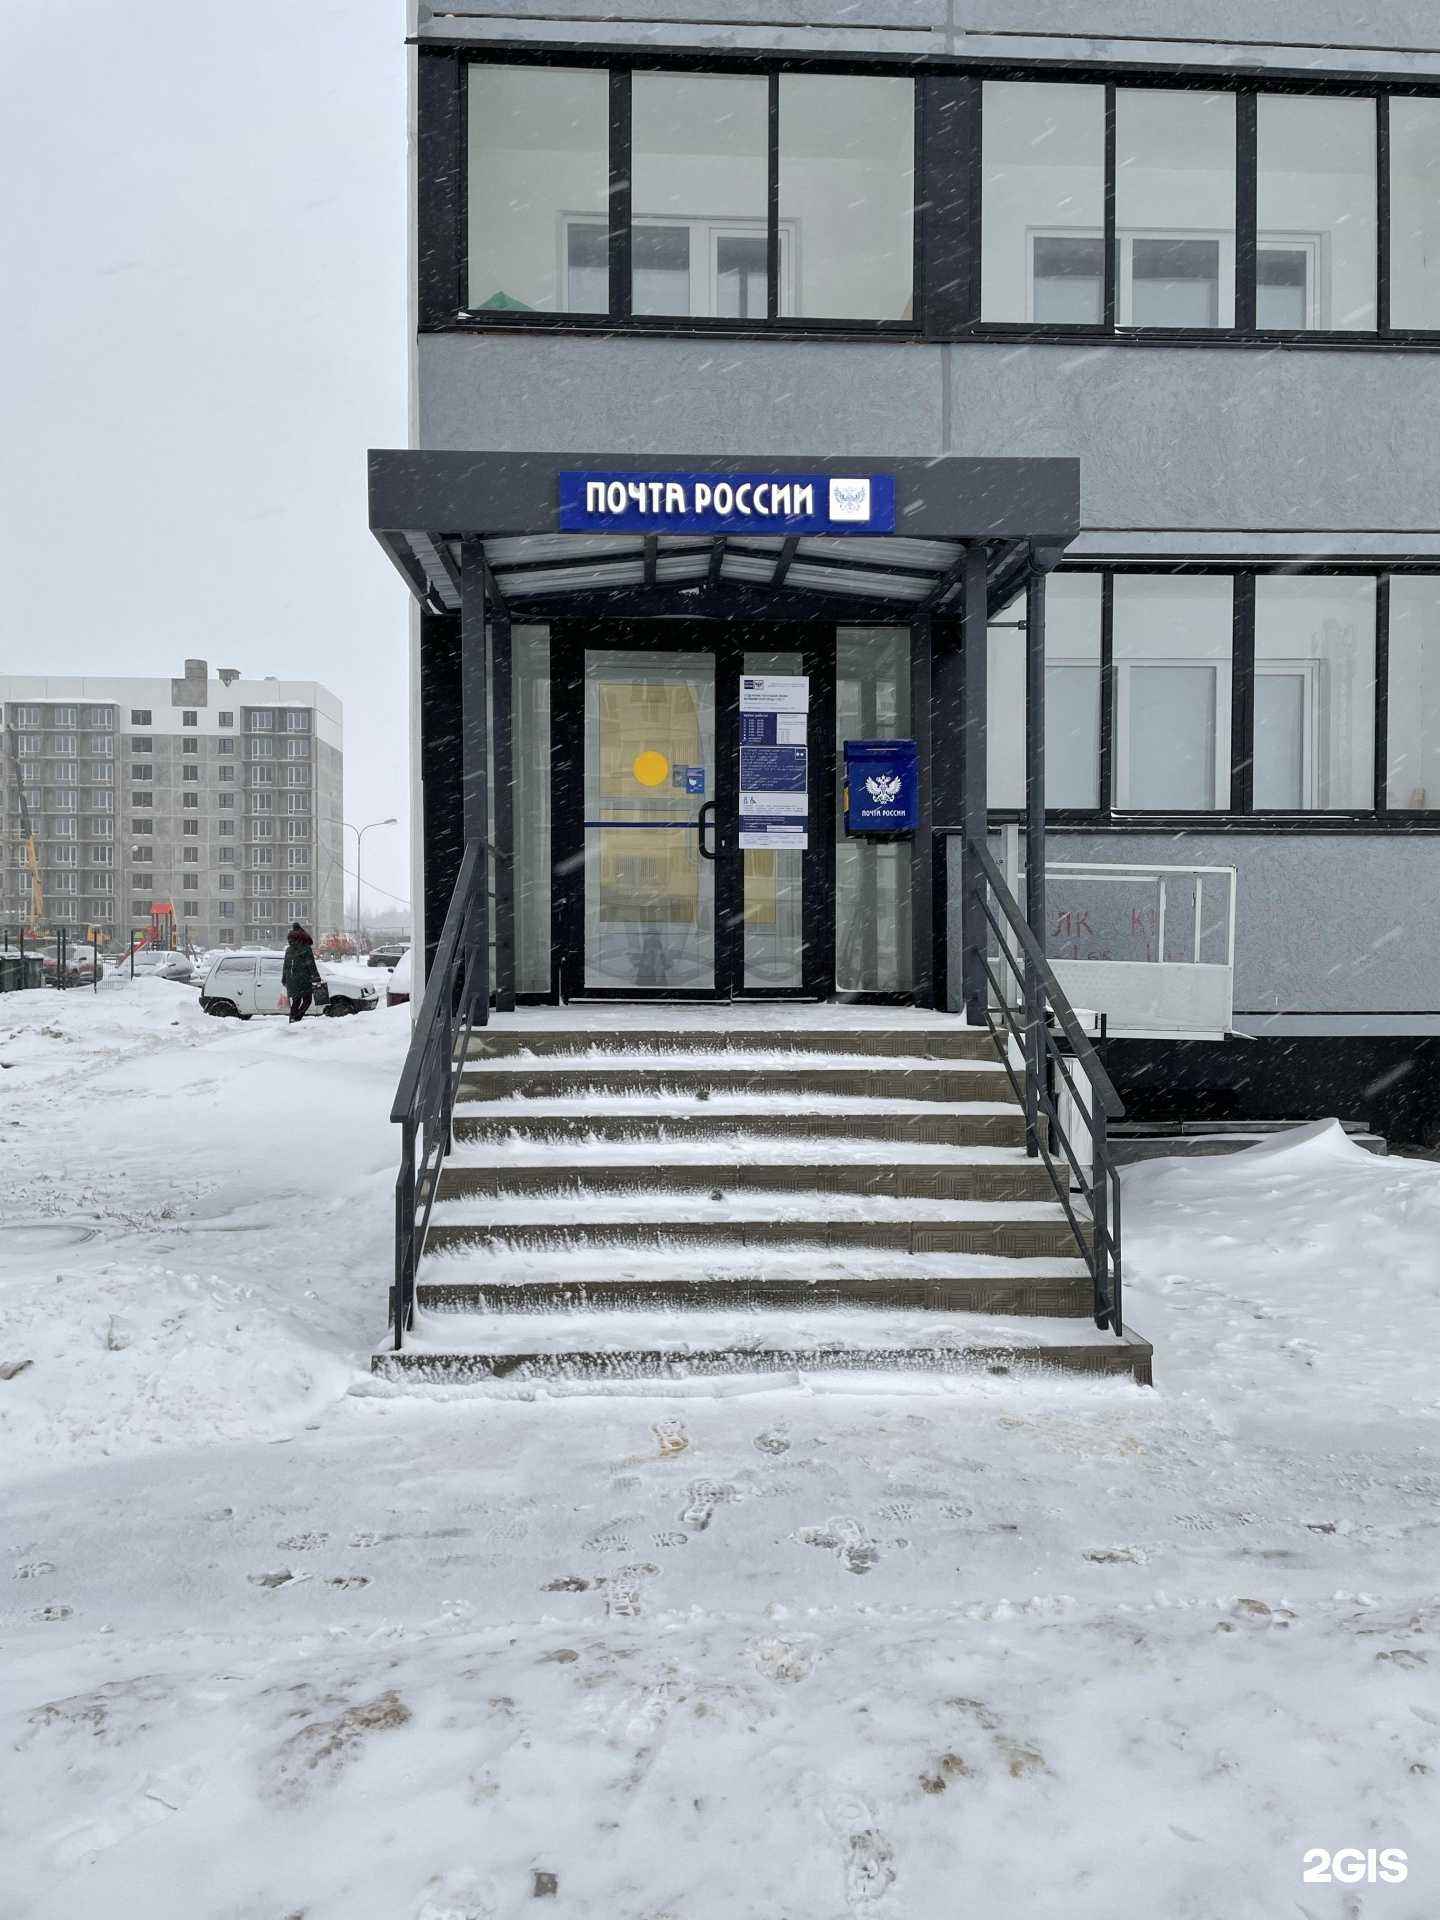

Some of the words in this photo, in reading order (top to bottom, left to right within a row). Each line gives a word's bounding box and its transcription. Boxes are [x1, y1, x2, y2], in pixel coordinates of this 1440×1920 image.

[586, 481, 686, 514] ПОЧТА
[695, 482, 814, 515] РОССИИ
[882, 809, 906, 817] РОССИИ
